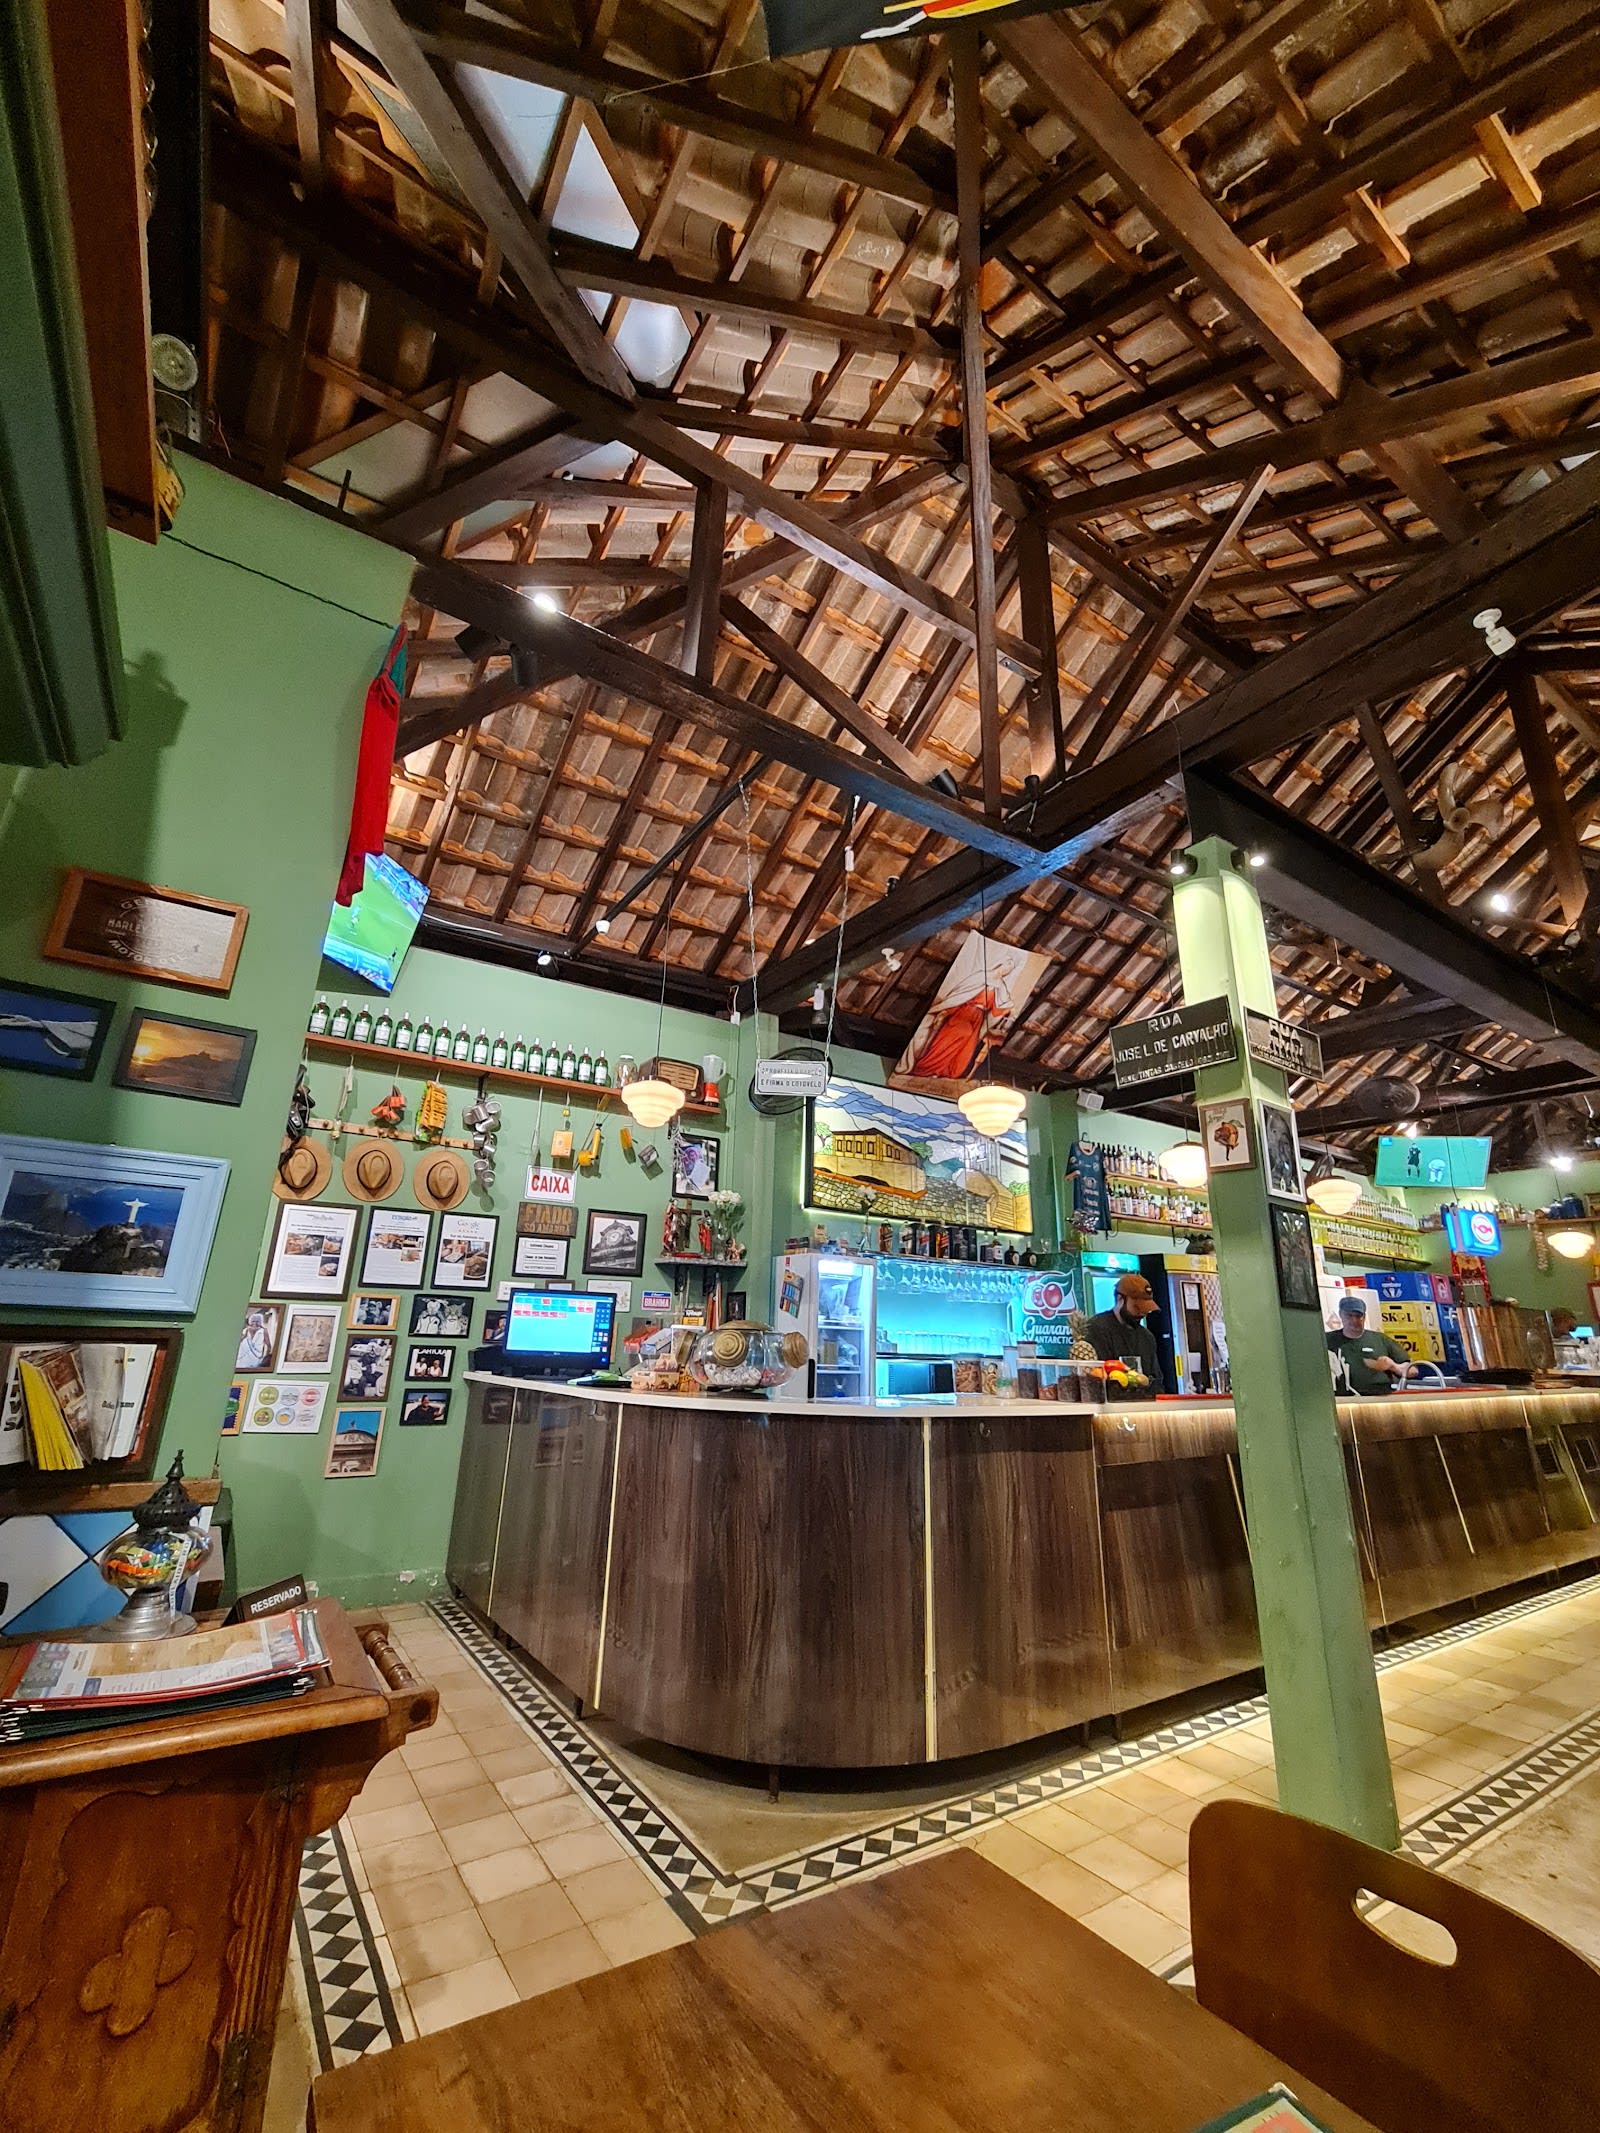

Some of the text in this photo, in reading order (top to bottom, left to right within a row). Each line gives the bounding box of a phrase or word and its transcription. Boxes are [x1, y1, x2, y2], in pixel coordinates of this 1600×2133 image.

[1148, 1012, 1182, 1033] RUA
[1268, 1019, 1300, 1042] RUA
[1154, 1039, 1168, 1054] DE
[1172, 1021, 1228, 1049] CARVALHO
[765, 1079, 784, 1087] FIRMA
[791, 1080, 822, 1088] COTOVELO
[531, 1174, 570, 1194] CAIXA
[525, 1203, 573, 1225] FIADO
[644, 1298, 669, 1307] BRAHMA
[1381, 1312, 1415, 1322] SKOL
[1023, 1315, 1073, 1341] Guaran
[1035, 1335, 1075, 1345] ANTARCTIC
[250, 1585, 302, 1614] RESERVADO
